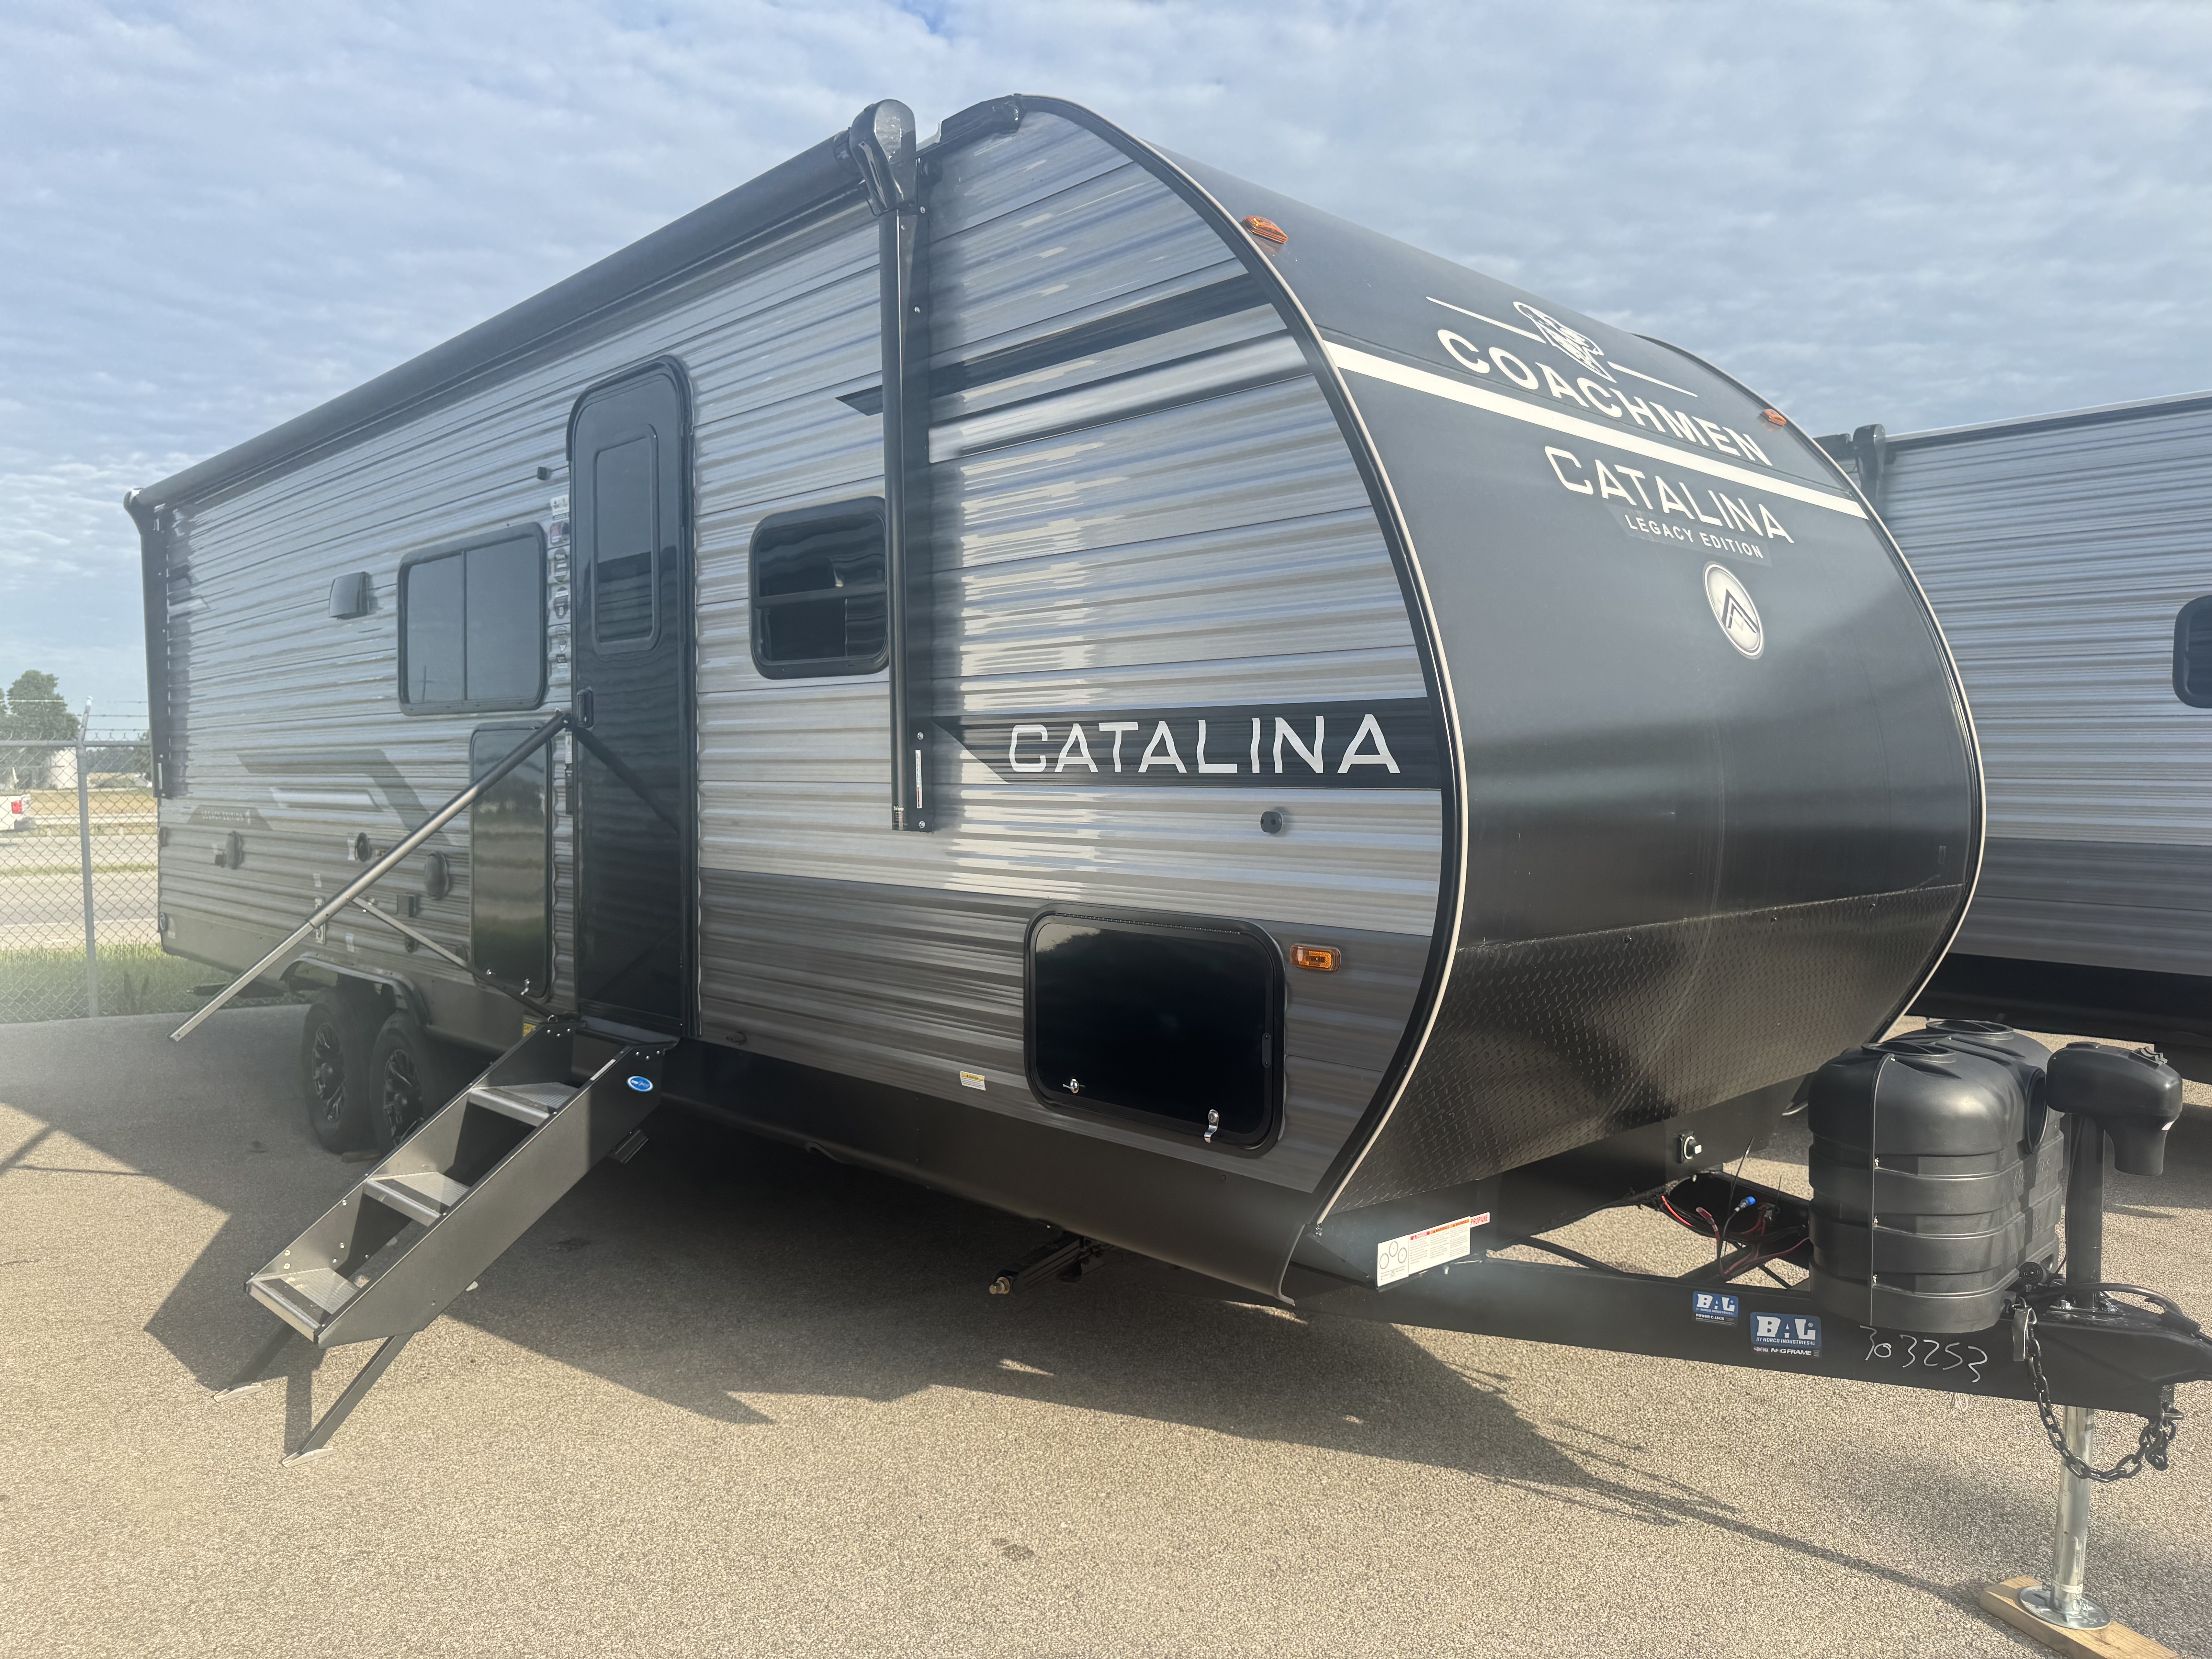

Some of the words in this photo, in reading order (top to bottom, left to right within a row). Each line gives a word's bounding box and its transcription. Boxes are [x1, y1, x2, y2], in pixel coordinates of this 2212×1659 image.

[1437, 329, 1773, 466] COACHMEN
[1544, 446, 1794, 544] CATALINA
[1625, 514, 1695, 544] LEGACY
[1700, 532, 1764, 559] EDITION
[1009, 714, 1401, 774] CATALINA
